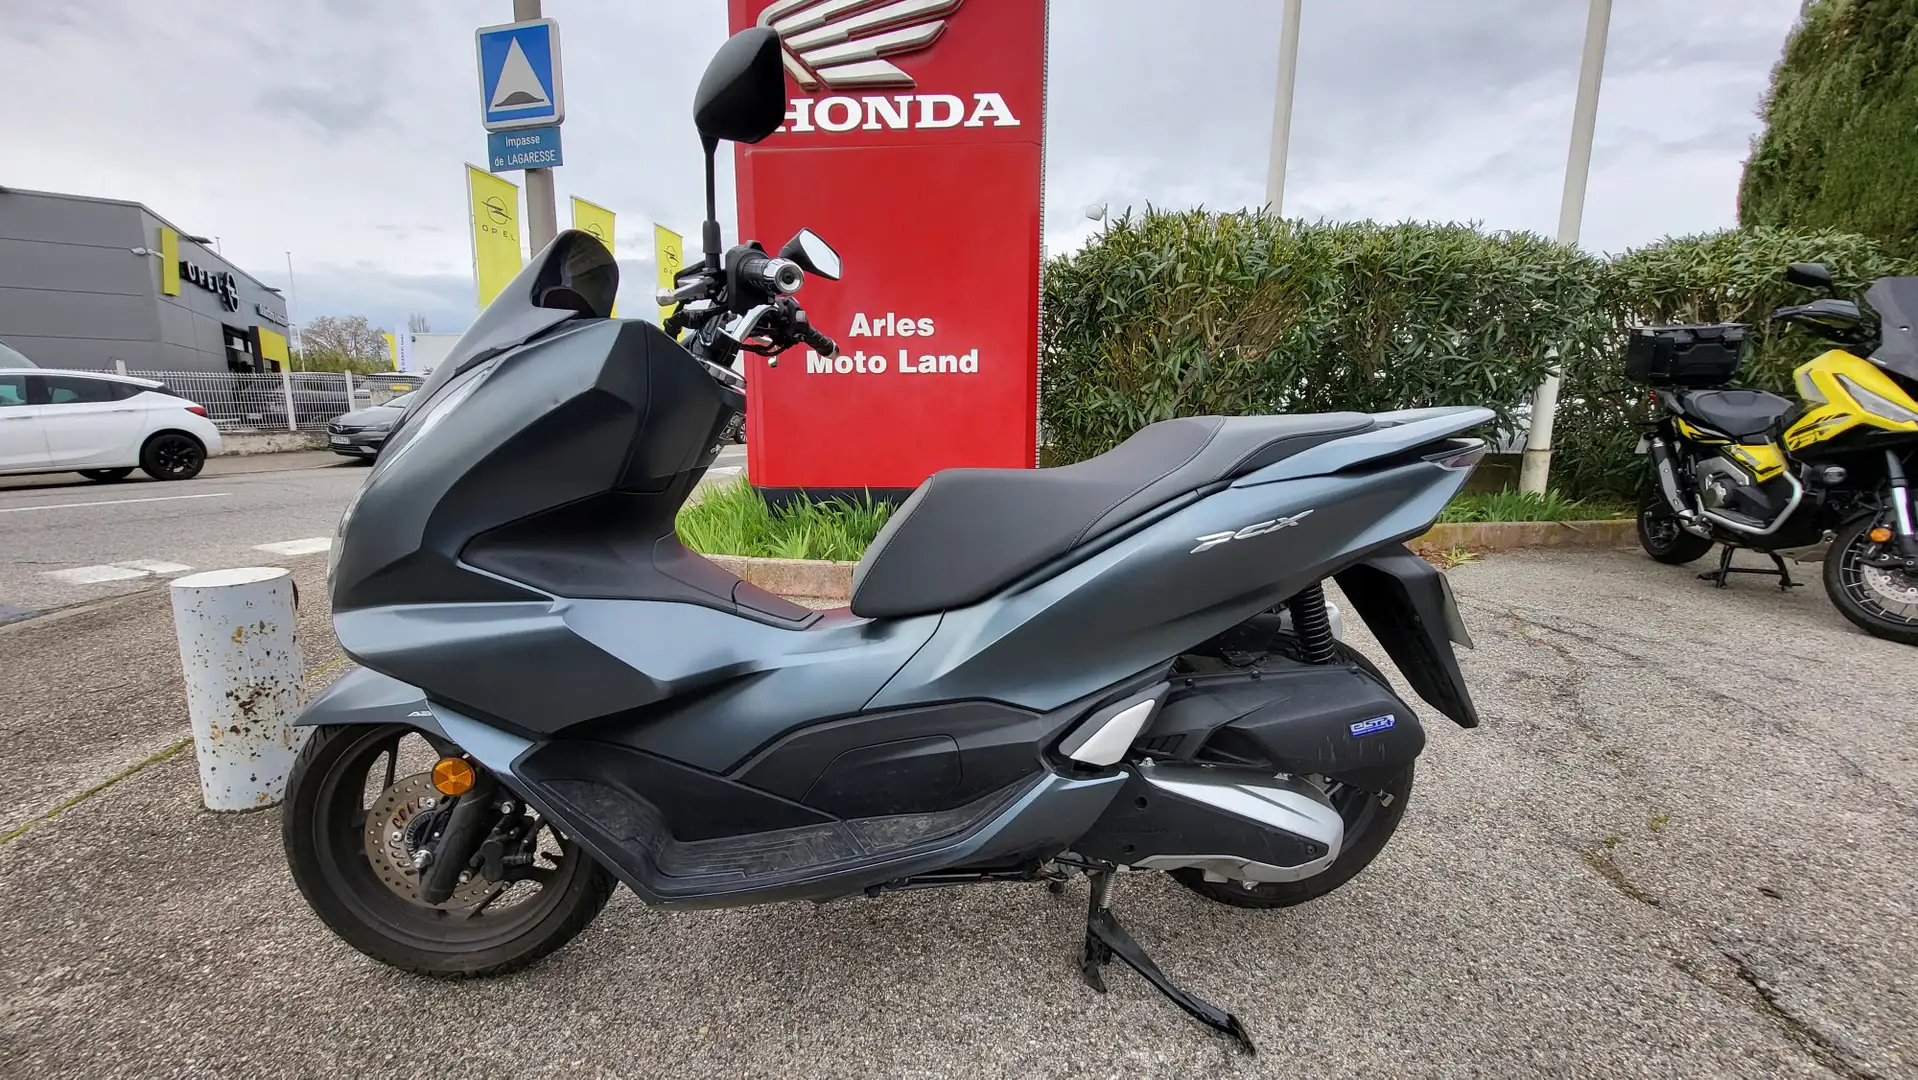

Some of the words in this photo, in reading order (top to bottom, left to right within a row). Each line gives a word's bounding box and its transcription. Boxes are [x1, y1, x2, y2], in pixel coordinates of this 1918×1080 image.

[774, 92, 1021, 132] HONDA
[505, 134, 541, 148] Impasse
[494, 157, 505, 167] de
[507, 149, 557, 165] LAGARESSE
[481, 224, 516, 242] OPEL
[187, 260, 223, 295] OPEL
[848, 312, 935, 338] Arles
[806, 349, 888, 375] Moto
[898, 348, 979, 374] Land
[1189, 509, 1315, 554] PCX
